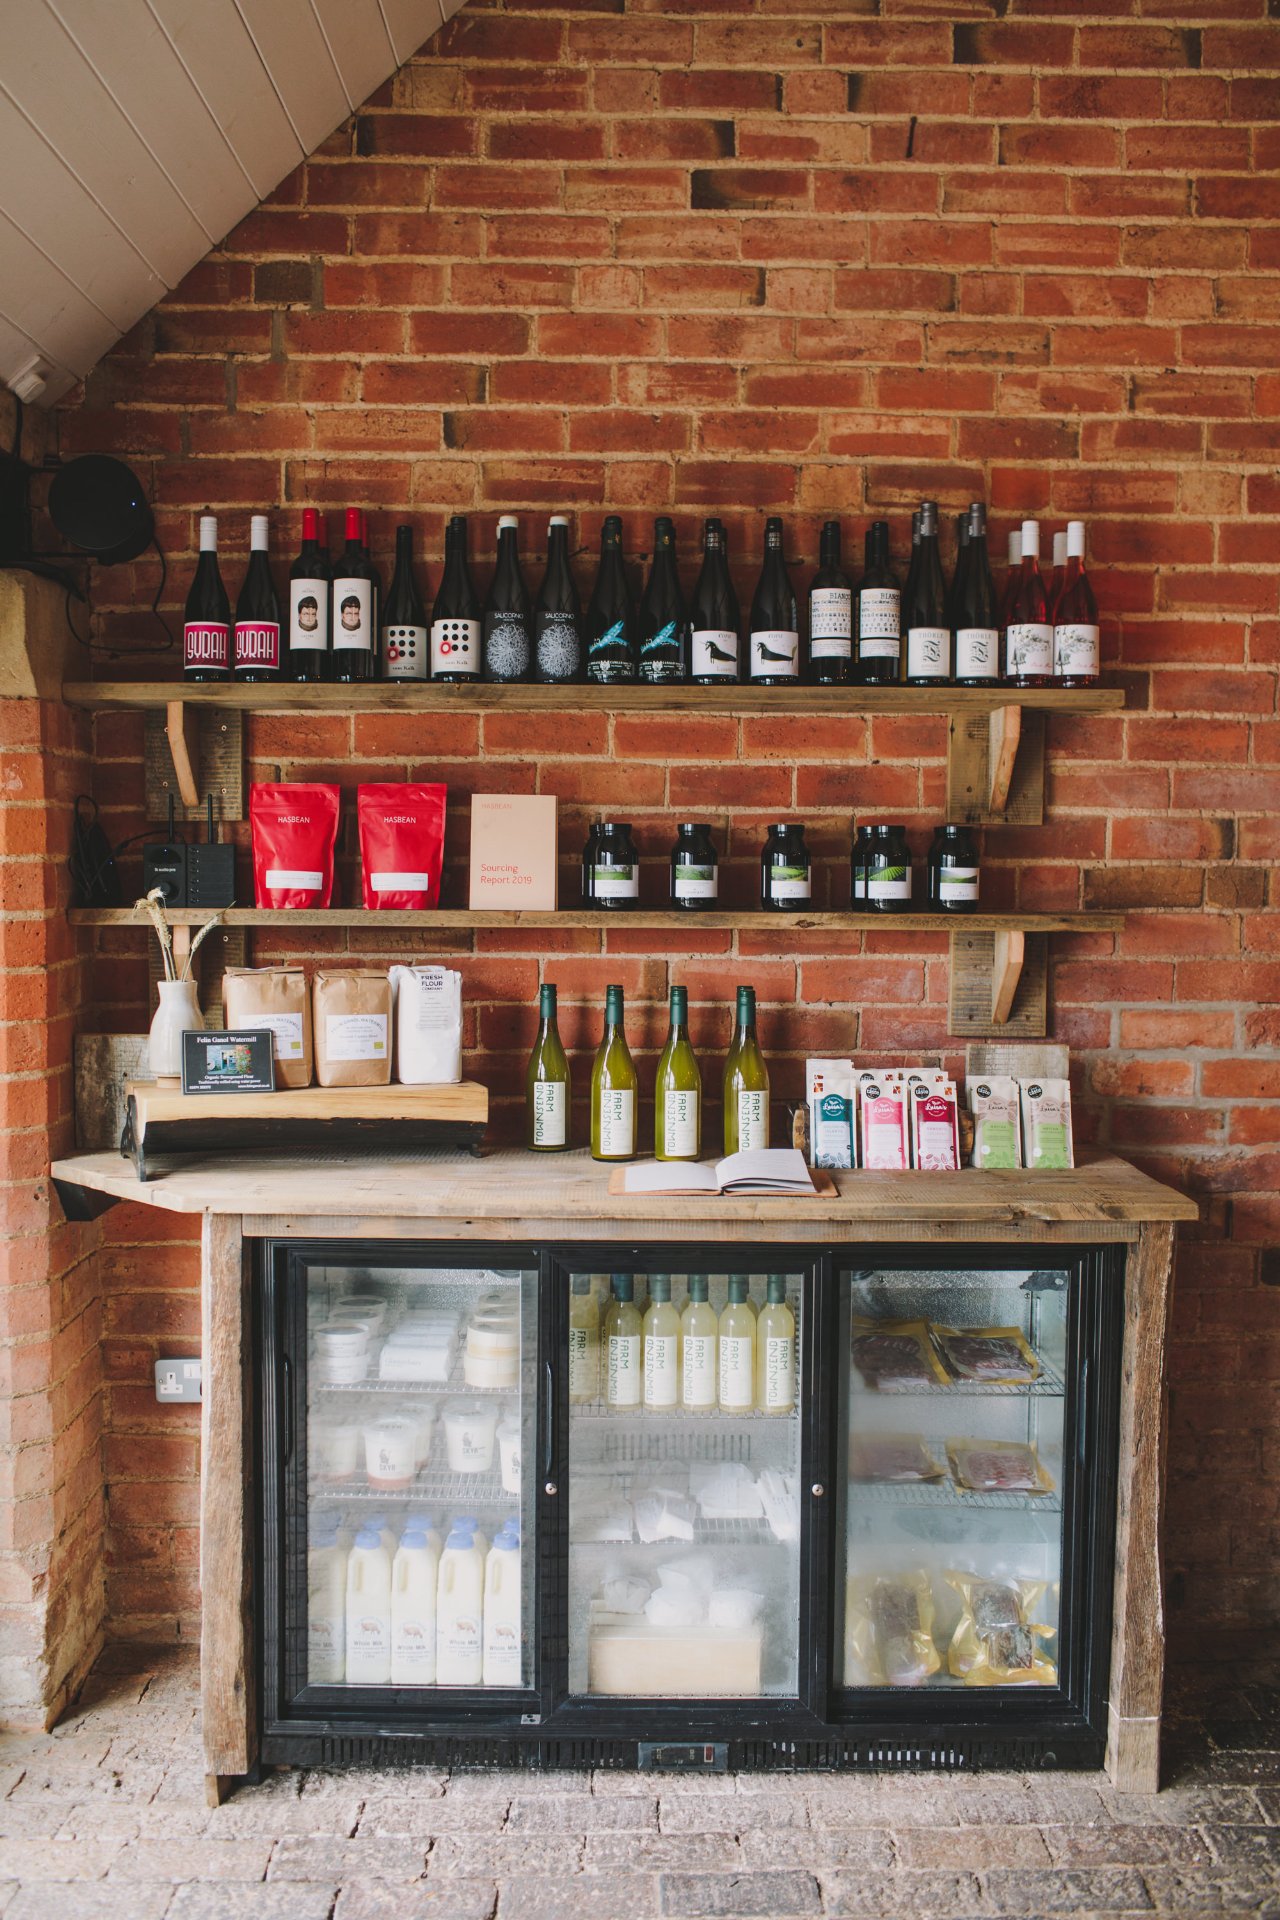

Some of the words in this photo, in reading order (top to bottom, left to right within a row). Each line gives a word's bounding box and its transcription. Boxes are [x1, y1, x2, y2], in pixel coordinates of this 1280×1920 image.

[187, 631, 226, 660] SYRAH
[236, 631, 274, 660] SYRAH
[278, 816, 310, 824] HASBEAN
[383, 816, 416, 824] HASBEAN
[480, 875, 510, 886] Report
[512, 876, 532, 884] 2019
[481, 863, 519, 874] Sourcing
[546, 1084, 554, 1112] FARM
[613, 1092, 622, 1121] FARM
[678, 1093, 686, 1122] FARM
[752, 1093, 760, 1122] FARM
[535, 1084, 544, 1143] TOWNSEND
[603, 1092, 611, 1152] TOWNSEND
[667, 1093, 676, 1152] TOWNSEND
[577, 1330, 586, 1360] FARM
[620, 1339, 629, 1369] FARM
[655, 1339, 665, 1369] FARM
[694, 1339, 704, 1369] FARM
[730, 1340, 739, 1370] FARM
[779, 1340, 789, 1370] FARM
[609, 1338, 618, 1401] TOWNSEND
[646, 1338, 654, 1401] TOWNSEND
[685, 1338, 693, 1401] TOWNSEND
[768, 1340, 778, 1403] TOWNSEND
